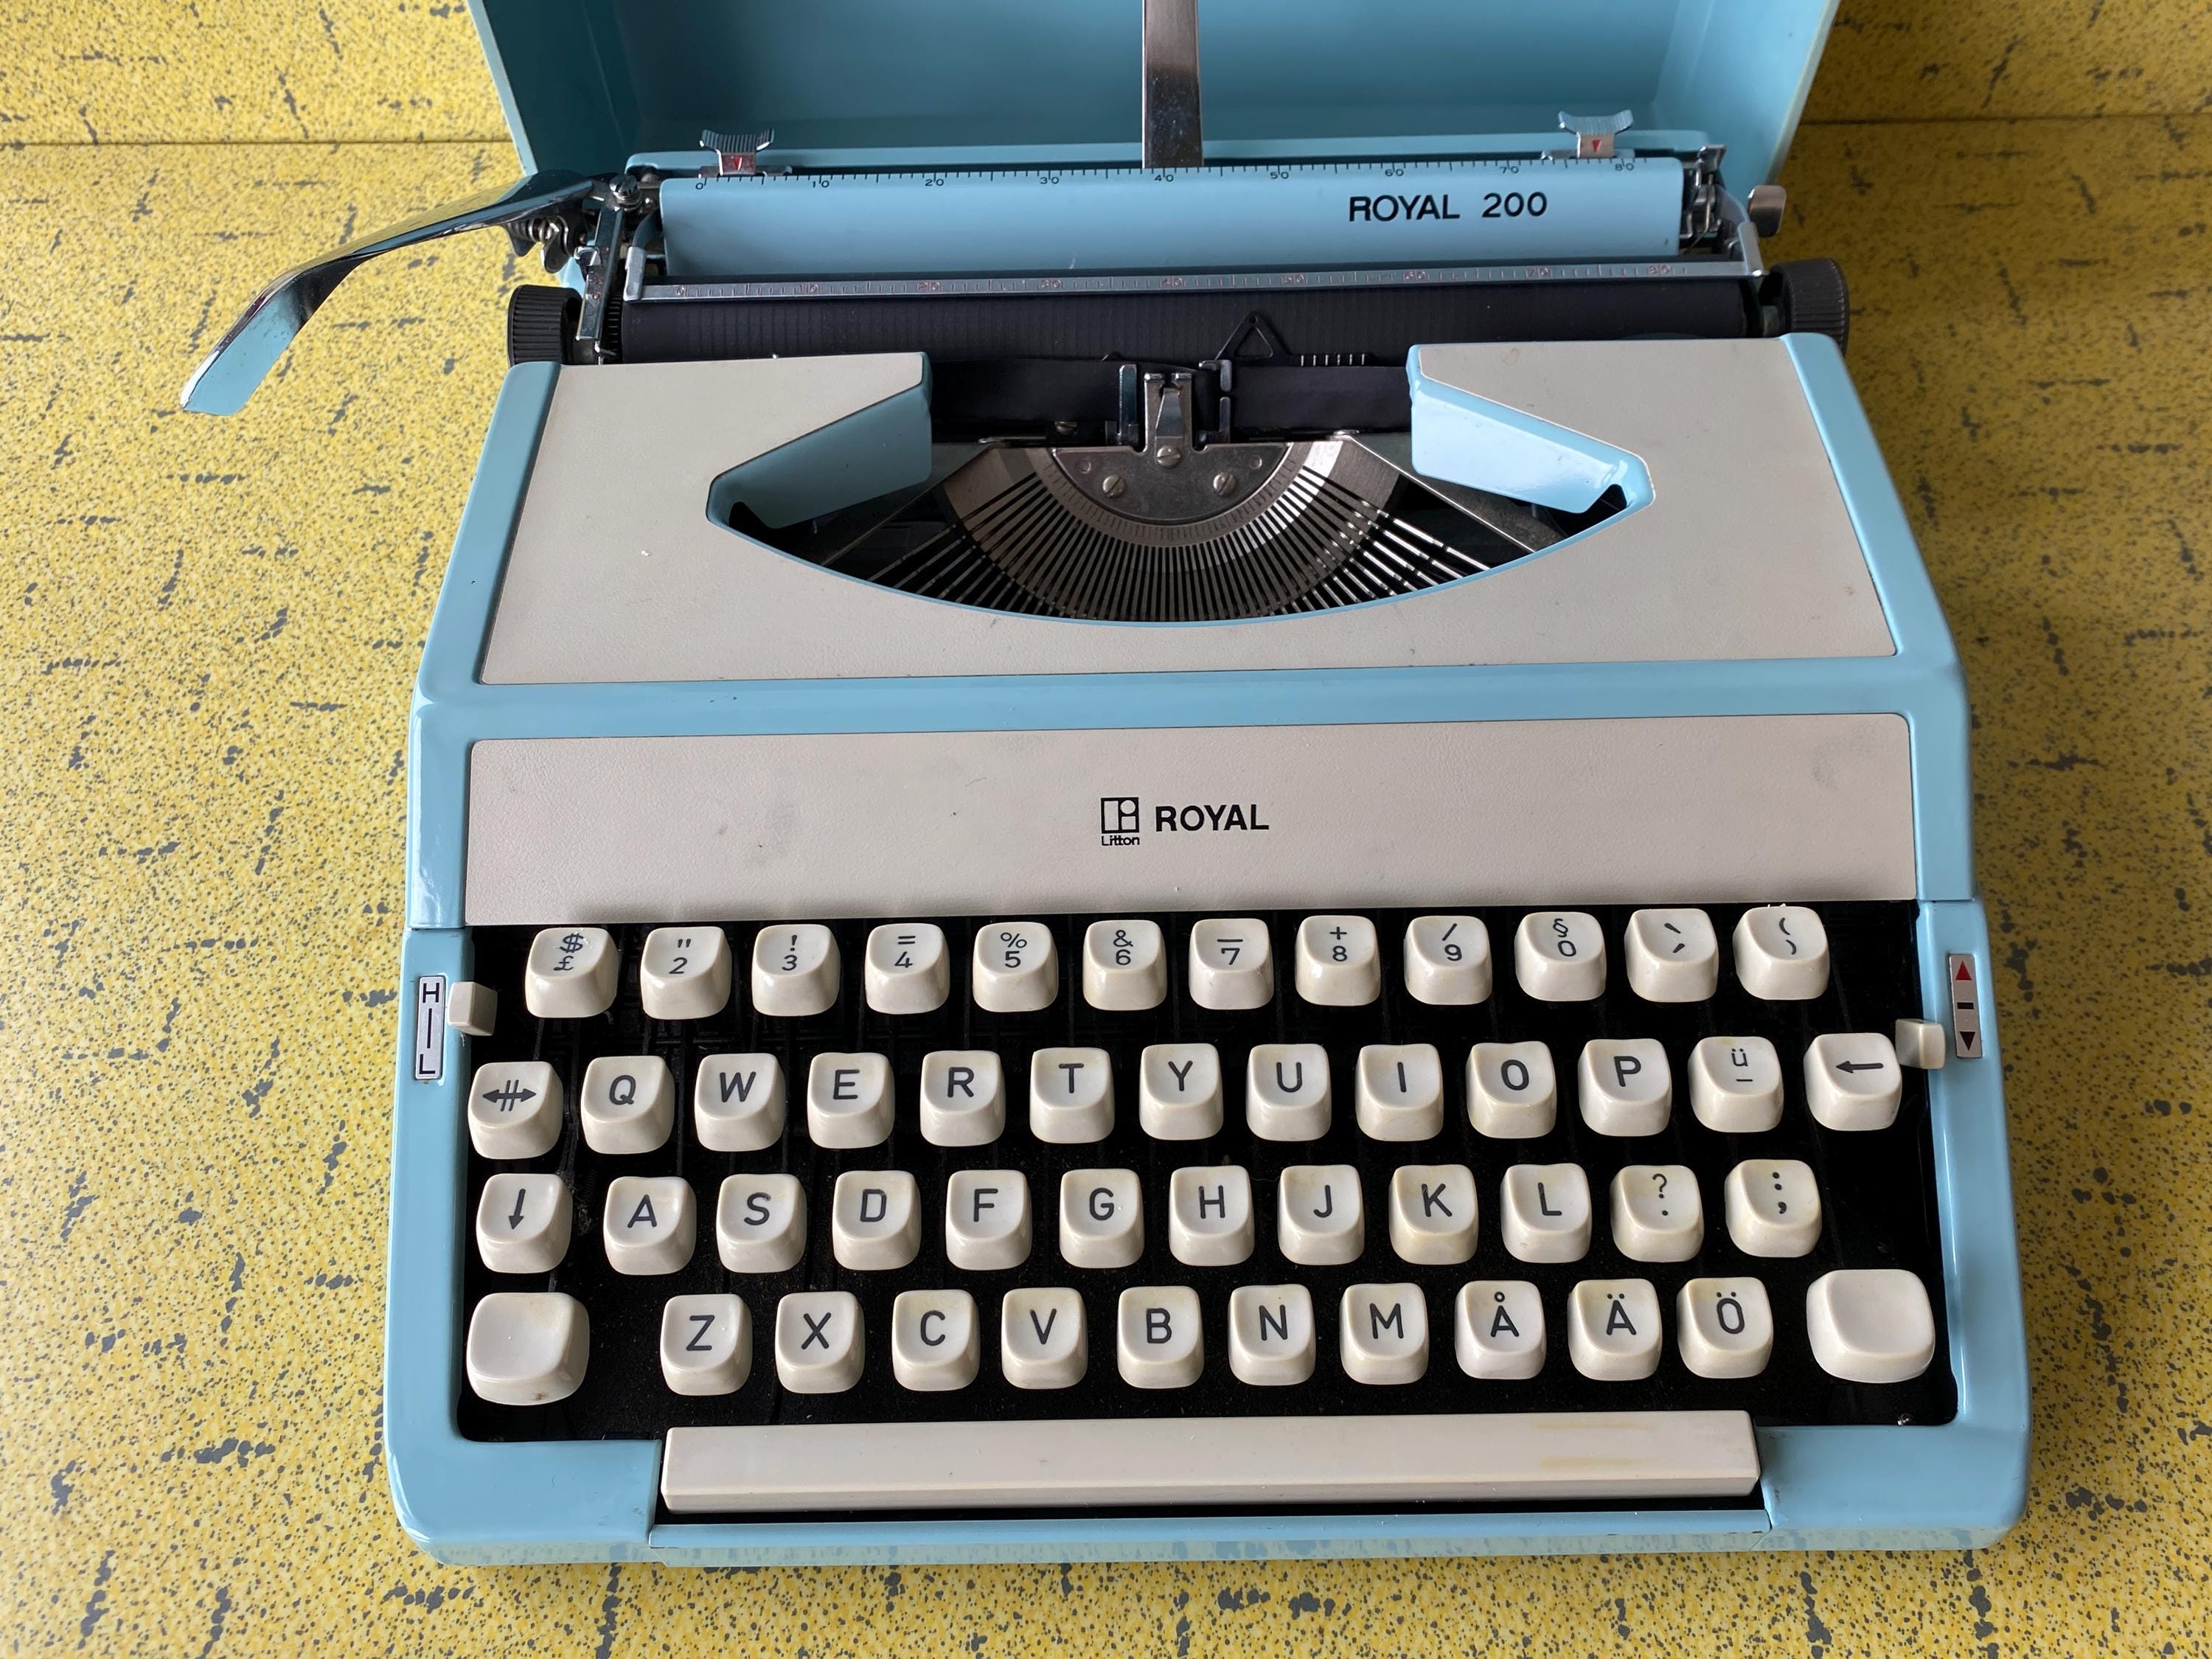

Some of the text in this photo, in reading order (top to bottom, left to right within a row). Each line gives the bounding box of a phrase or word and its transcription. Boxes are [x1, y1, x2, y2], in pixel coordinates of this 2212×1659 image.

[813, 180, 830, 188] 10
[925, 178, 944, 187] 20
[1155, 174, 1174, 182] 40
[1270, 171, 1289, 179] 50
[1385, 169, 1404, 177] 60
[1349, 192, 1548, 222] ROYAL 200
[1155, 804, 1270, 832] ROYAL
[1101, 835, 1140, 846] Litton
[559, 933, 584, 953] $
[1000, 932, 1028, 949] %
[1113, 929, 1134, 947] &
[1552, 918, 1569, 938] §
[553, 955, 574, 971] £
[668, 956, 688, 975] 2
[782, 954, 798, 971] 3
[894, 951, 914, 969] 4
[1004, 950, 1021, 968] 5
[1115, 949, 1131, 966] 6
[1220, 947, 1240, 965] 7
[1332, 945, 1348, 962] 8
[1444, 944, 1463, 961] 9
[422, 982, 440, 1004] H
[419, 1054, 435, 1074] L
[1613, 1055, 1641, 1088] P
[1731, 1048, 1748, 1067] ü
[608, 1074, 636, 1106] Q
[719, 1071, 757, 1103] W
[832, 1069, 860, 1100] E
[947, 1066, 975, 1098] R
[1058, 1062, 1085, 1094] T
[1167, 1060, 1193, 1092] Y
[1276, 1061, 1303, 1093] U
[1397, 1061, 1407, 1093] I
[1500, 1059, 1529, 1091] O
[1312, 1184, 1333, 1218] J
[1421, 1183, 1453, 1218] K
[1537, 1182, 1562, 1217] L
[1652, 1173, 1667, 1199] ?
[627, 1194, 658, 1228] A
[743, 1192, 771, 1226] S
[859, 1189, 887, 1222] D
[973, 1188, 999, 1222] F
[1088, 1187, 1115, 1221] G
[1198, 1185, 1225, 1220] H
[919, 1310, 946, 1346] C
[1029, 1308, 1057, 1345] V
[1145, 1307, 1172, 1344] B
[1259, 1304, 1288, 1341] N
[1369, 1303, 1404, 1340] M
[1490, 1291, 1520, 1338] Å
[1606, 1293, 1637, 1336] Ä
[1716, 1291, 1745, 1335] Ö
[685, 1315, 715, 1352] Z
[801, 1312, 832, 1350] X
